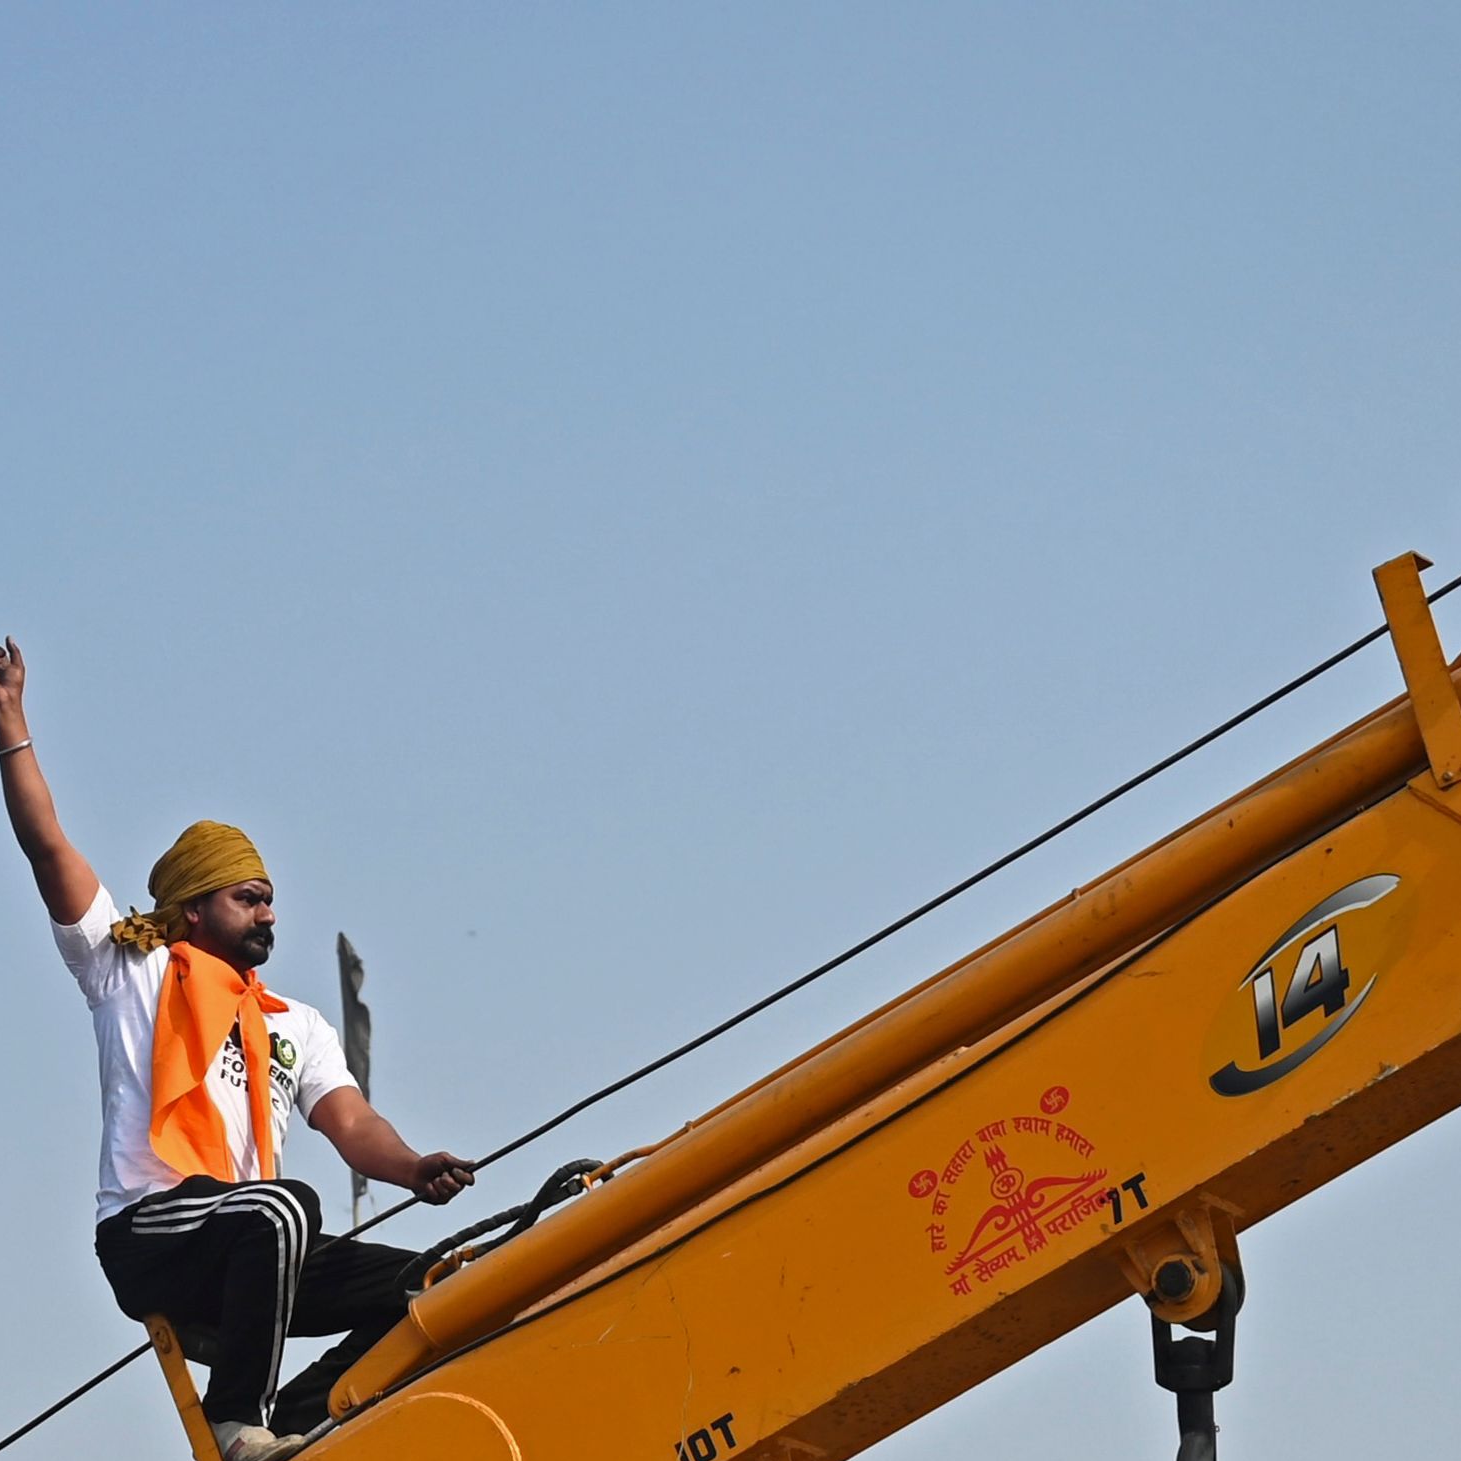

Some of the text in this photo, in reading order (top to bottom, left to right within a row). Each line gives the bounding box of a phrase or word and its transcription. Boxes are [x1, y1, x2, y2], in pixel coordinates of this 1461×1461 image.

[1252, 923, 1350, 1061] 14
[975, 1120, 1008, 1144] बाबा
[1012, 1116, 1052, 1136] श्याम
[1055, 1123, 1095, 1159] हमारा
[941, 1140, 976, 1186] सहारा
[932, 1190, 951, 1216] का
